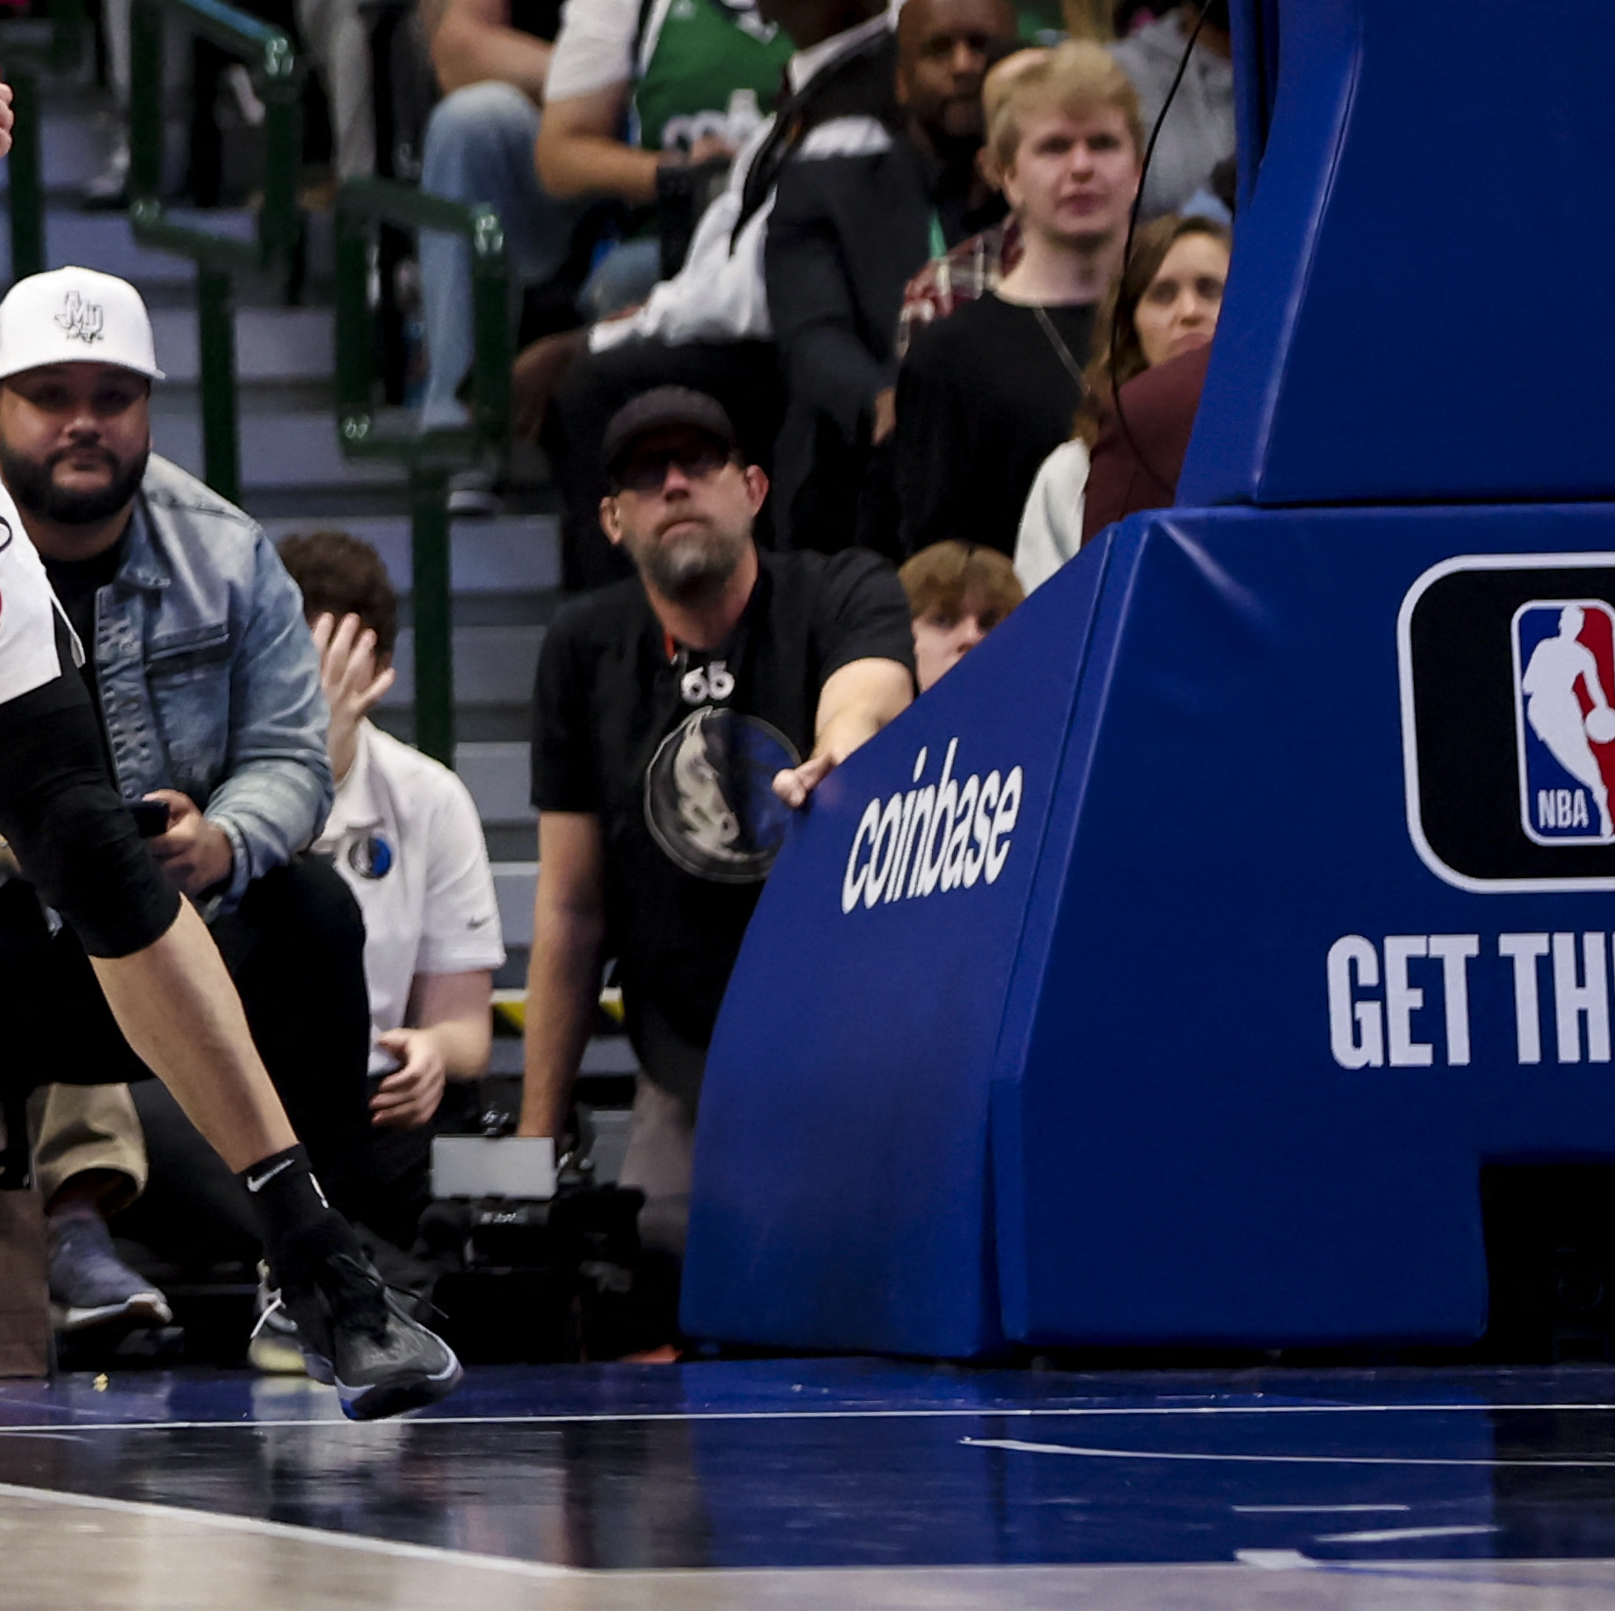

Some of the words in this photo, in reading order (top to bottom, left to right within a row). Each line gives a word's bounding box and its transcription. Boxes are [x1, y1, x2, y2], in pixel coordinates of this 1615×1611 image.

[841, 736, 1023, 915] coinbase
[1537, 788, 1589, 829] NBA
[1326, 934, 1480, 1070] GET
[1498, 931, 1615, 1065] TH
